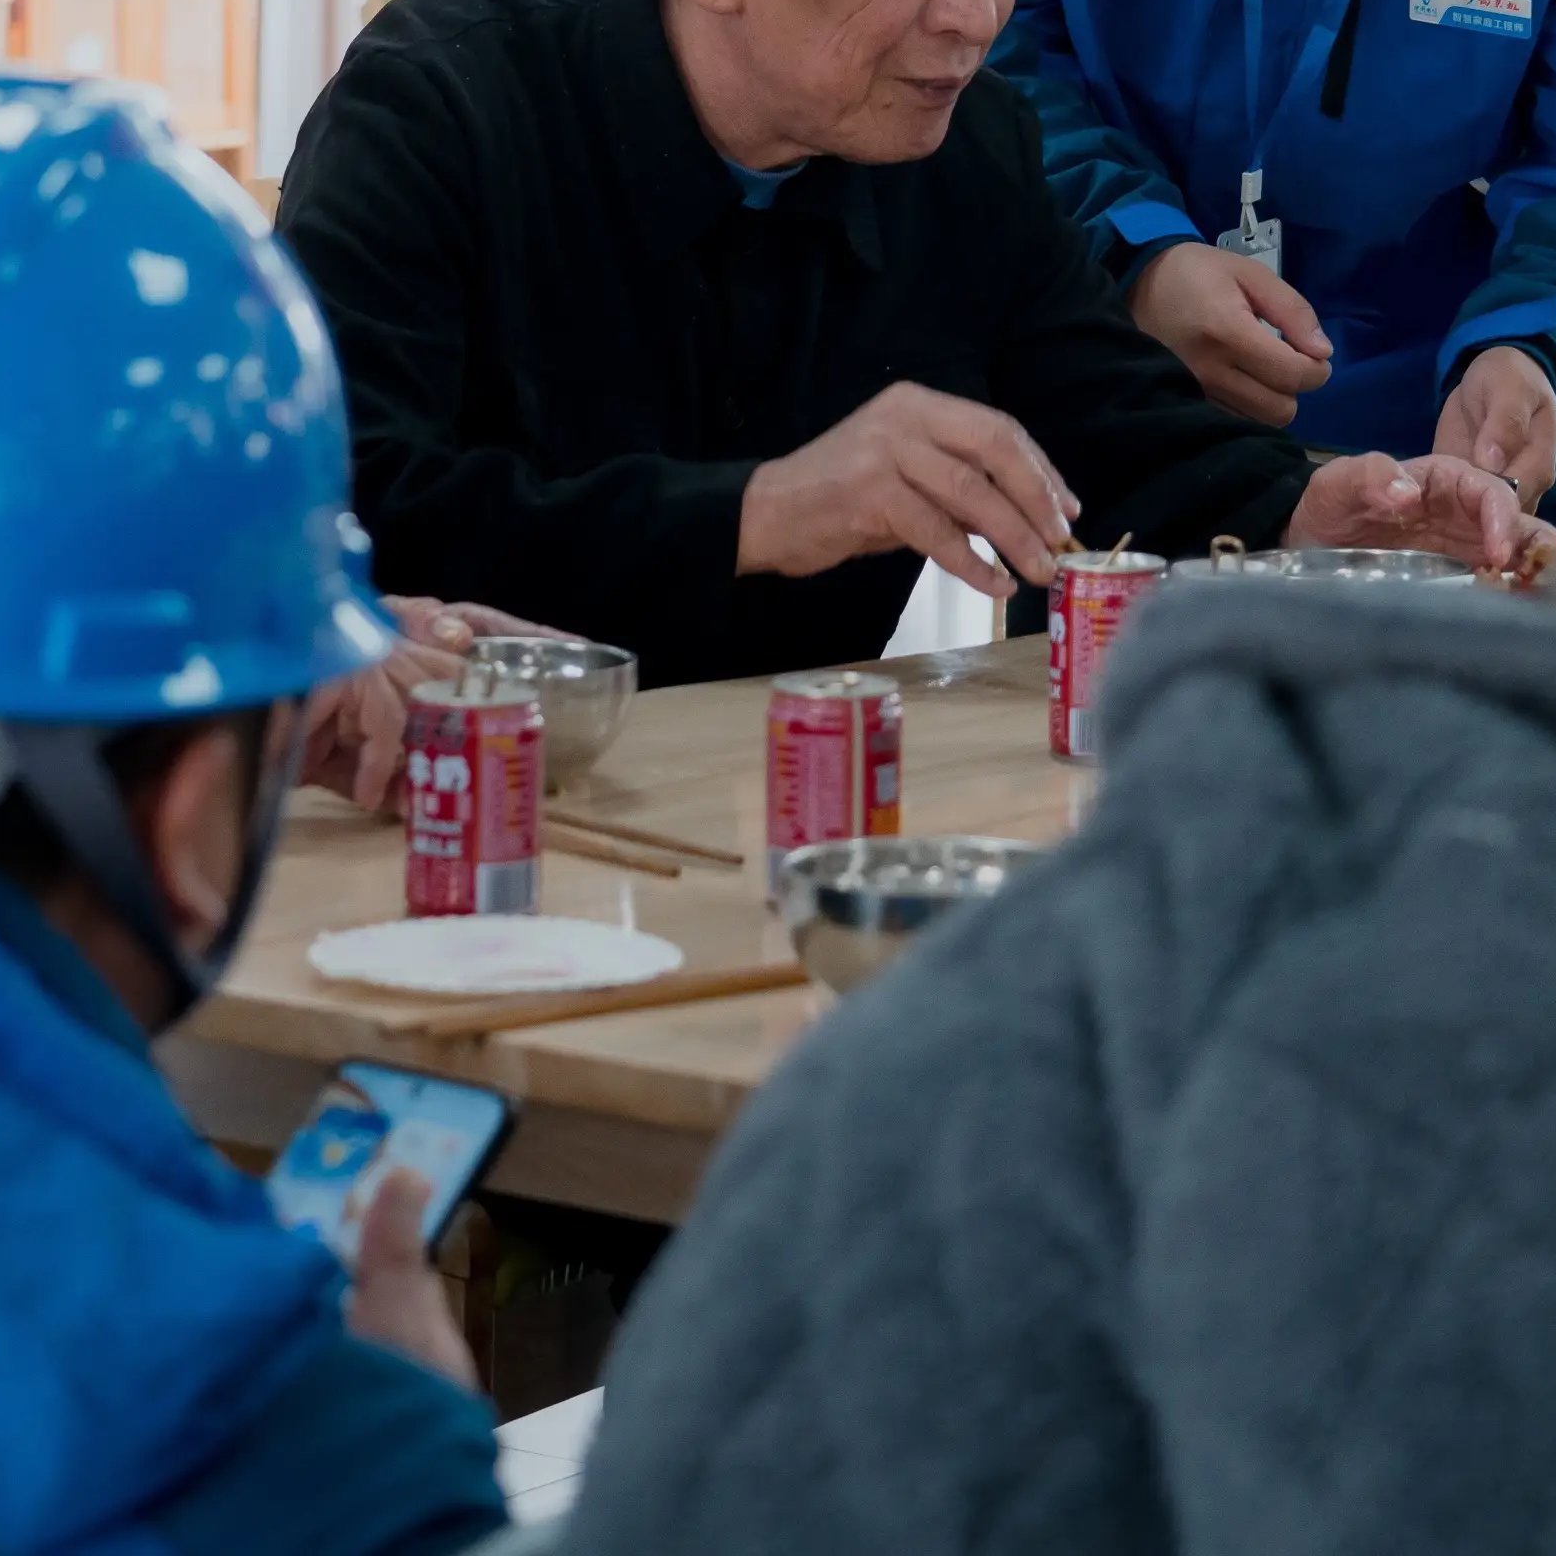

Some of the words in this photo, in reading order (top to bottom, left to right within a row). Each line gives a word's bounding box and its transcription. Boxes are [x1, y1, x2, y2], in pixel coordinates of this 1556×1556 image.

[1452, 11, 1525, 32] 智慧家庭工程师
